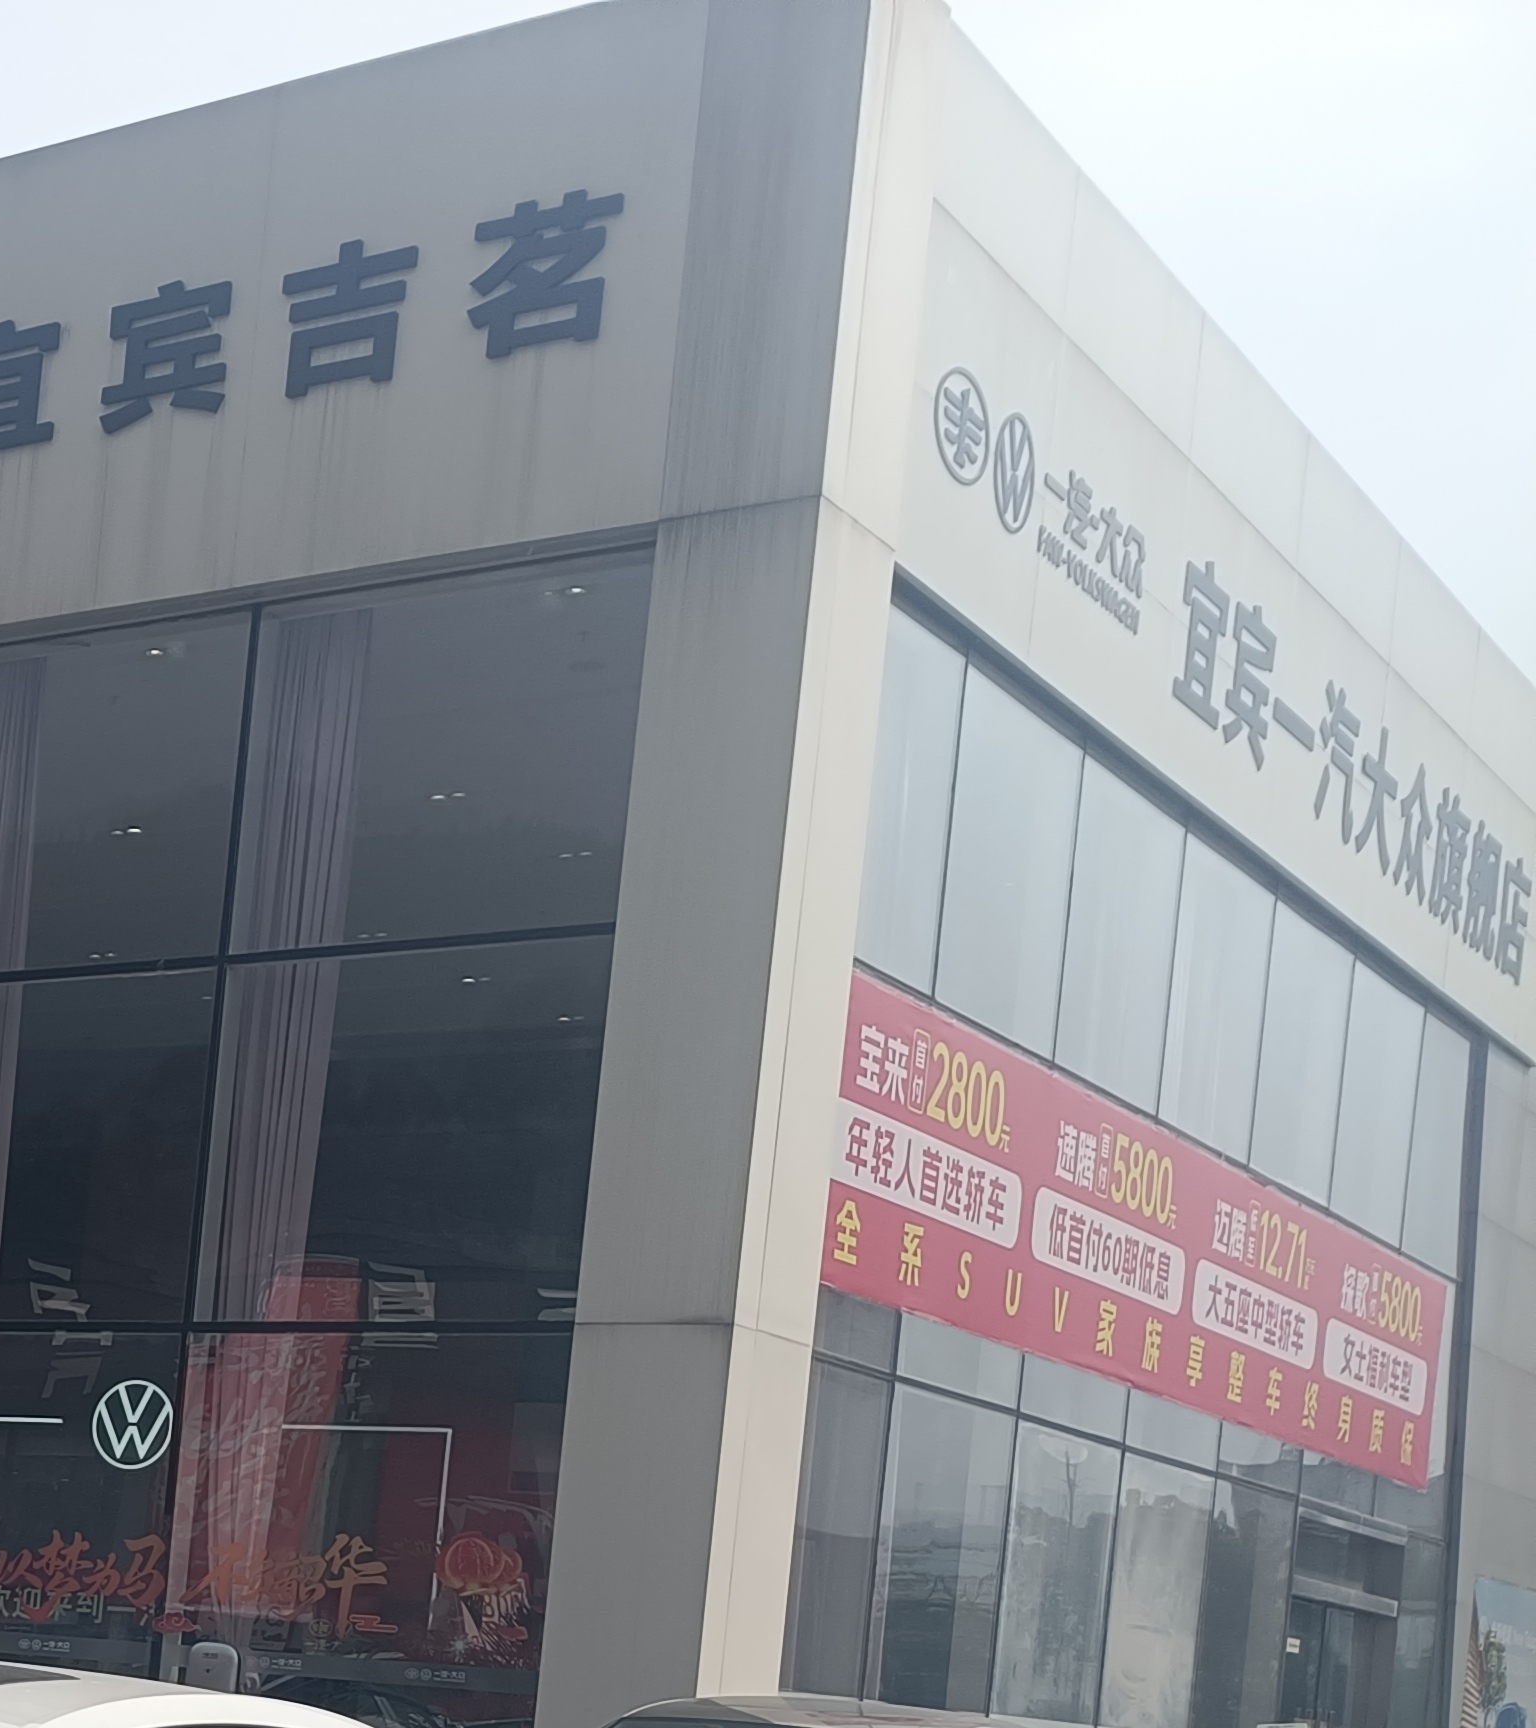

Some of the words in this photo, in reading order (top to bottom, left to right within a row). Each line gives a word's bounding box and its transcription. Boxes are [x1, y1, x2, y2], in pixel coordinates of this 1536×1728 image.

[1171, 559, 1533, 986] 宜宾一汽大众旗舰店
[855, 1024, 910, 1105] 宝来
[926, 1041, 1011, 1153] 2800元
[844, 1116, 1007, 1231] 年轻人首选轿车
[1054, 1119, 1098, 1192] 速腾
[1110, 1132, 1177, 1230] 5800元
[1048, 1203, 1172, 1301] 低首付60期低息
[1211, 1198, 1248, 1262] 迈腾
[1204, 1273, 1306, 1357] 大五座中型轿车
[1339, 1333, 1414, 1403] 女士福利车型
